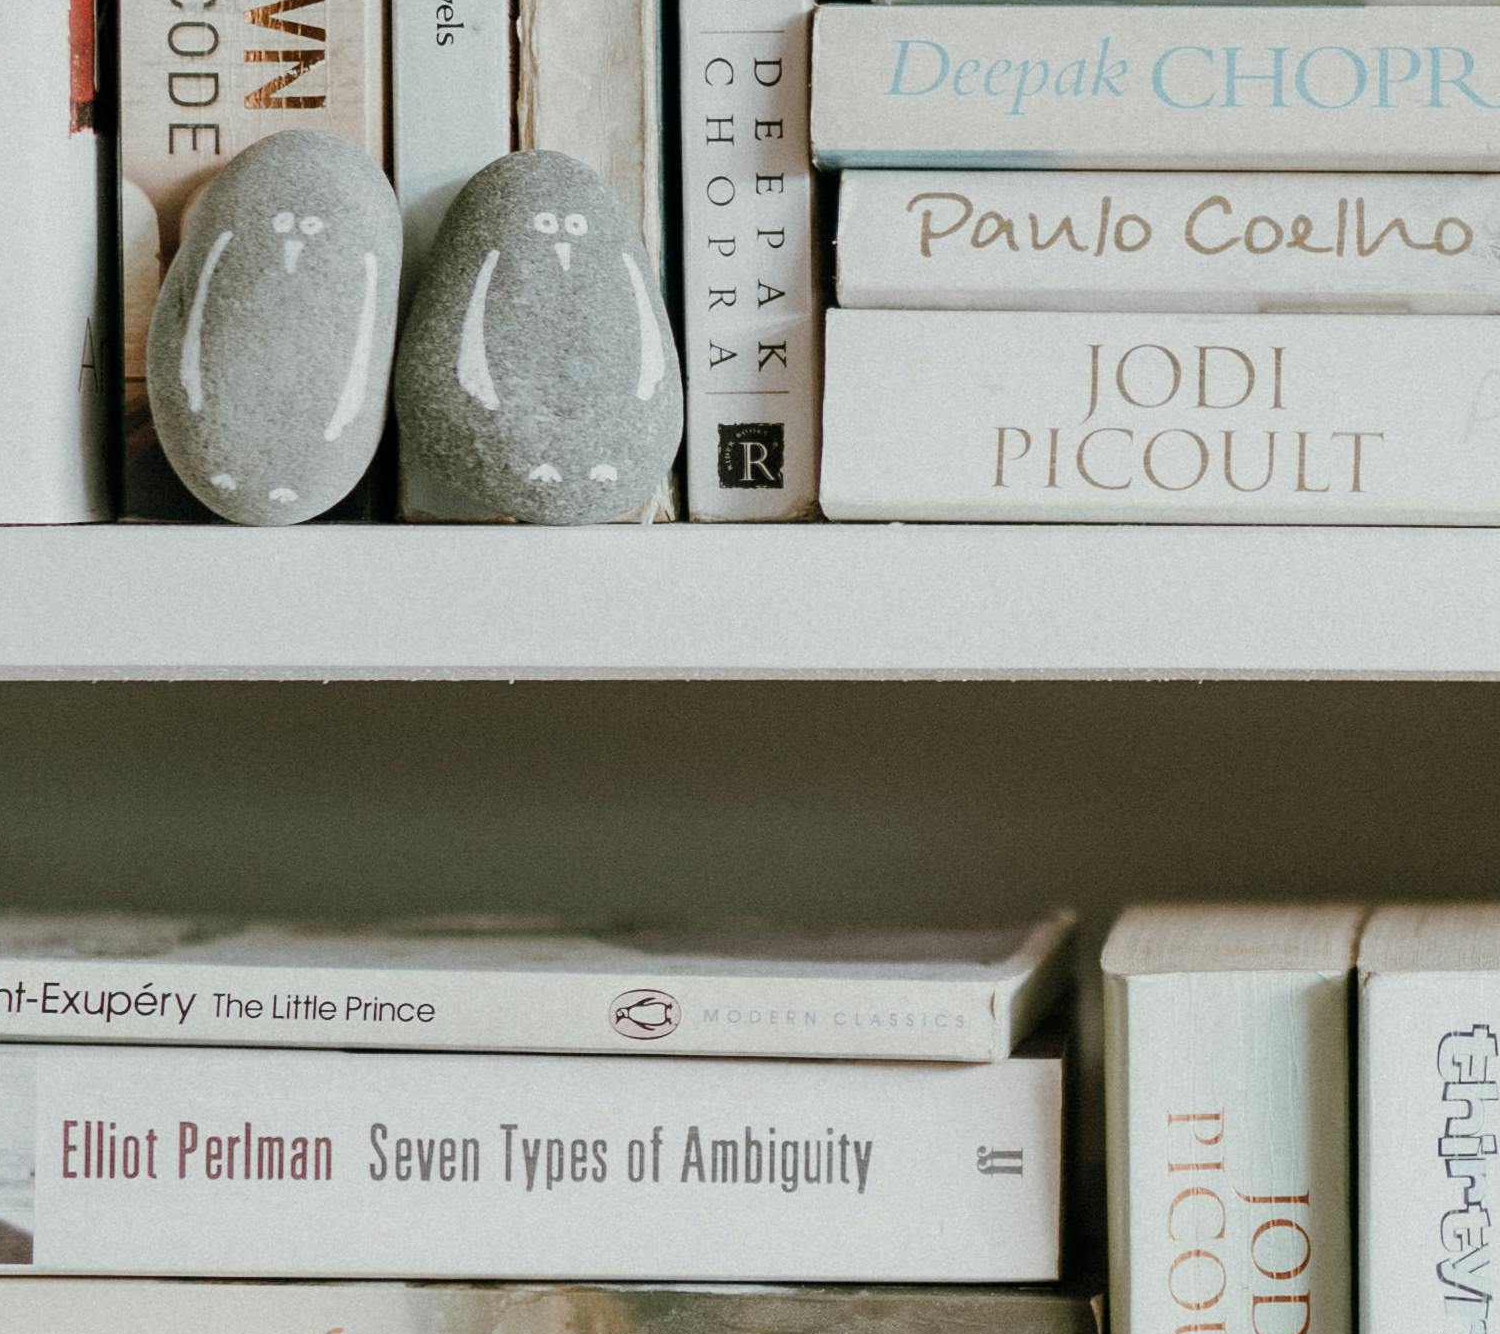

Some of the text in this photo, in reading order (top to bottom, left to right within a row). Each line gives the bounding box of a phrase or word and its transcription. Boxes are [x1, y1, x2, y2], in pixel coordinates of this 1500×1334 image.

[704, 56, 739, 370] CHOPRA
[754, 58, 788, 373] DEEPAK
[906, 192, 1153, 257] Paulo
[1183, 195, 1474, 257] Coelho
[1079, 344, 1287, 423] JODI
[991, 425, 1384, 494] PICOULT
[213, 992, 261, 1019] The
[272, 993, 337, 1022] Little
[345, 995, 436, 1025] Prince
[62, 1120, 873, 1195] Elliot Perlman Seven Types of Ambiguity
